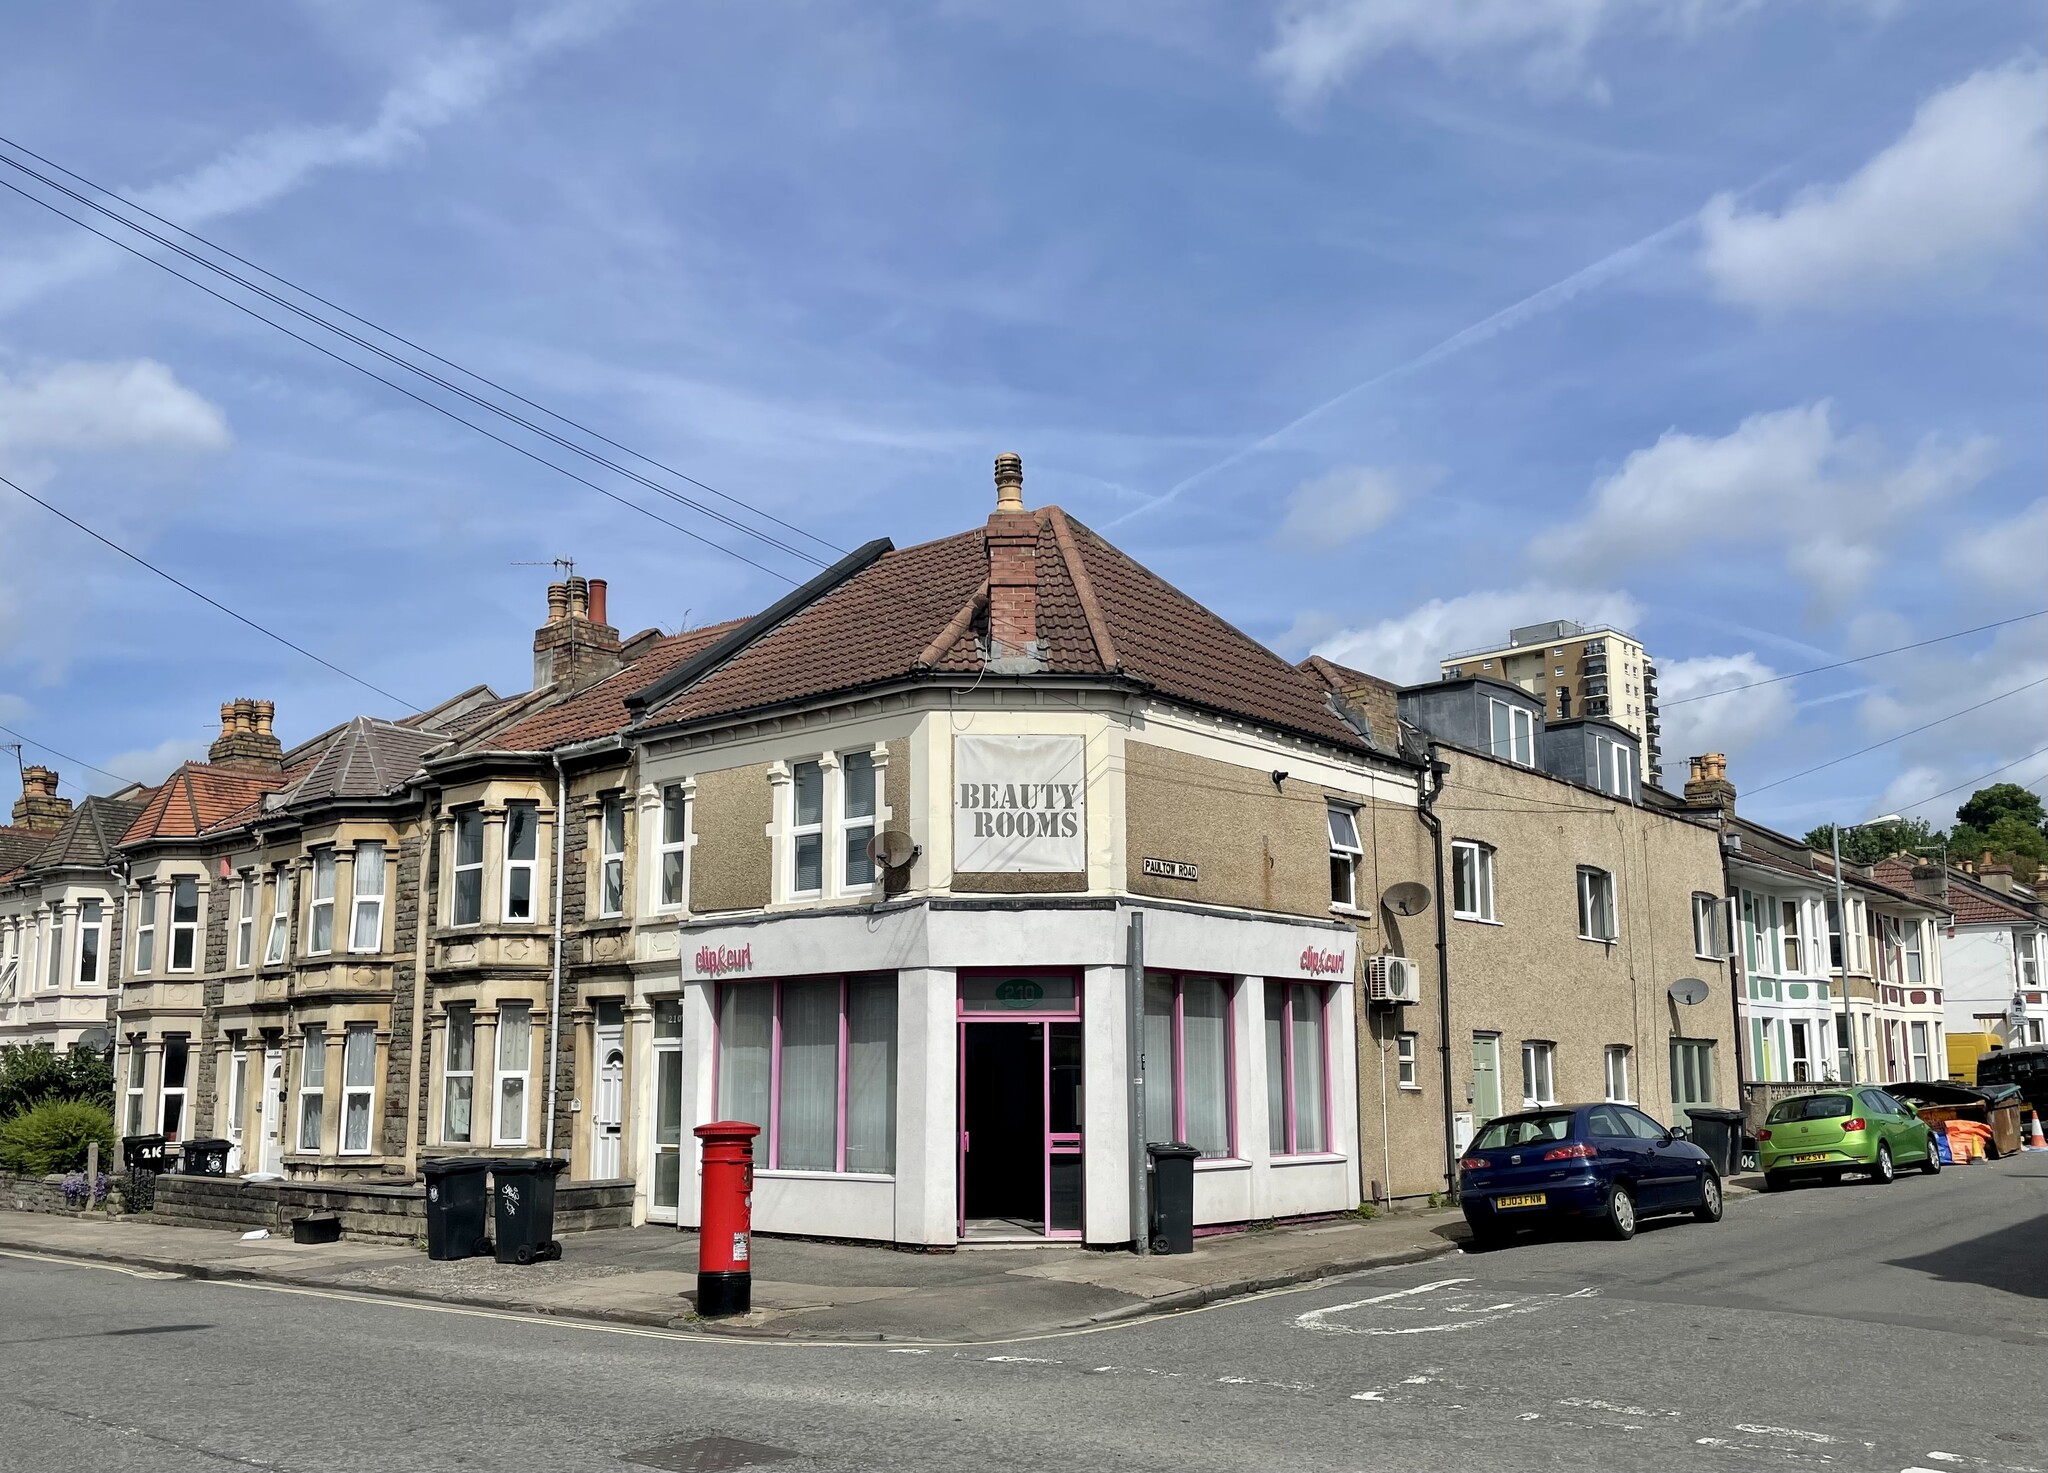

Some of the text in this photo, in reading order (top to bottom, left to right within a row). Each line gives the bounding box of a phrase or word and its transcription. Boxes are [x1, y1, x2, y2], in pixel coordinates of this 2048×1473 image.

[960, 783, 1078, 809] BEAUTY
[974, 811, 1078, 838] ROOMS
[1145, 860, 1197, 878] PAULTOW ROAD
[1004, 985, 1035, 1001] 210
[668, 1015, 682, 1024] 210
[1741, 1155, 1756, 1169] 06
[1501, 1195, 1522, 1206] BJ03
